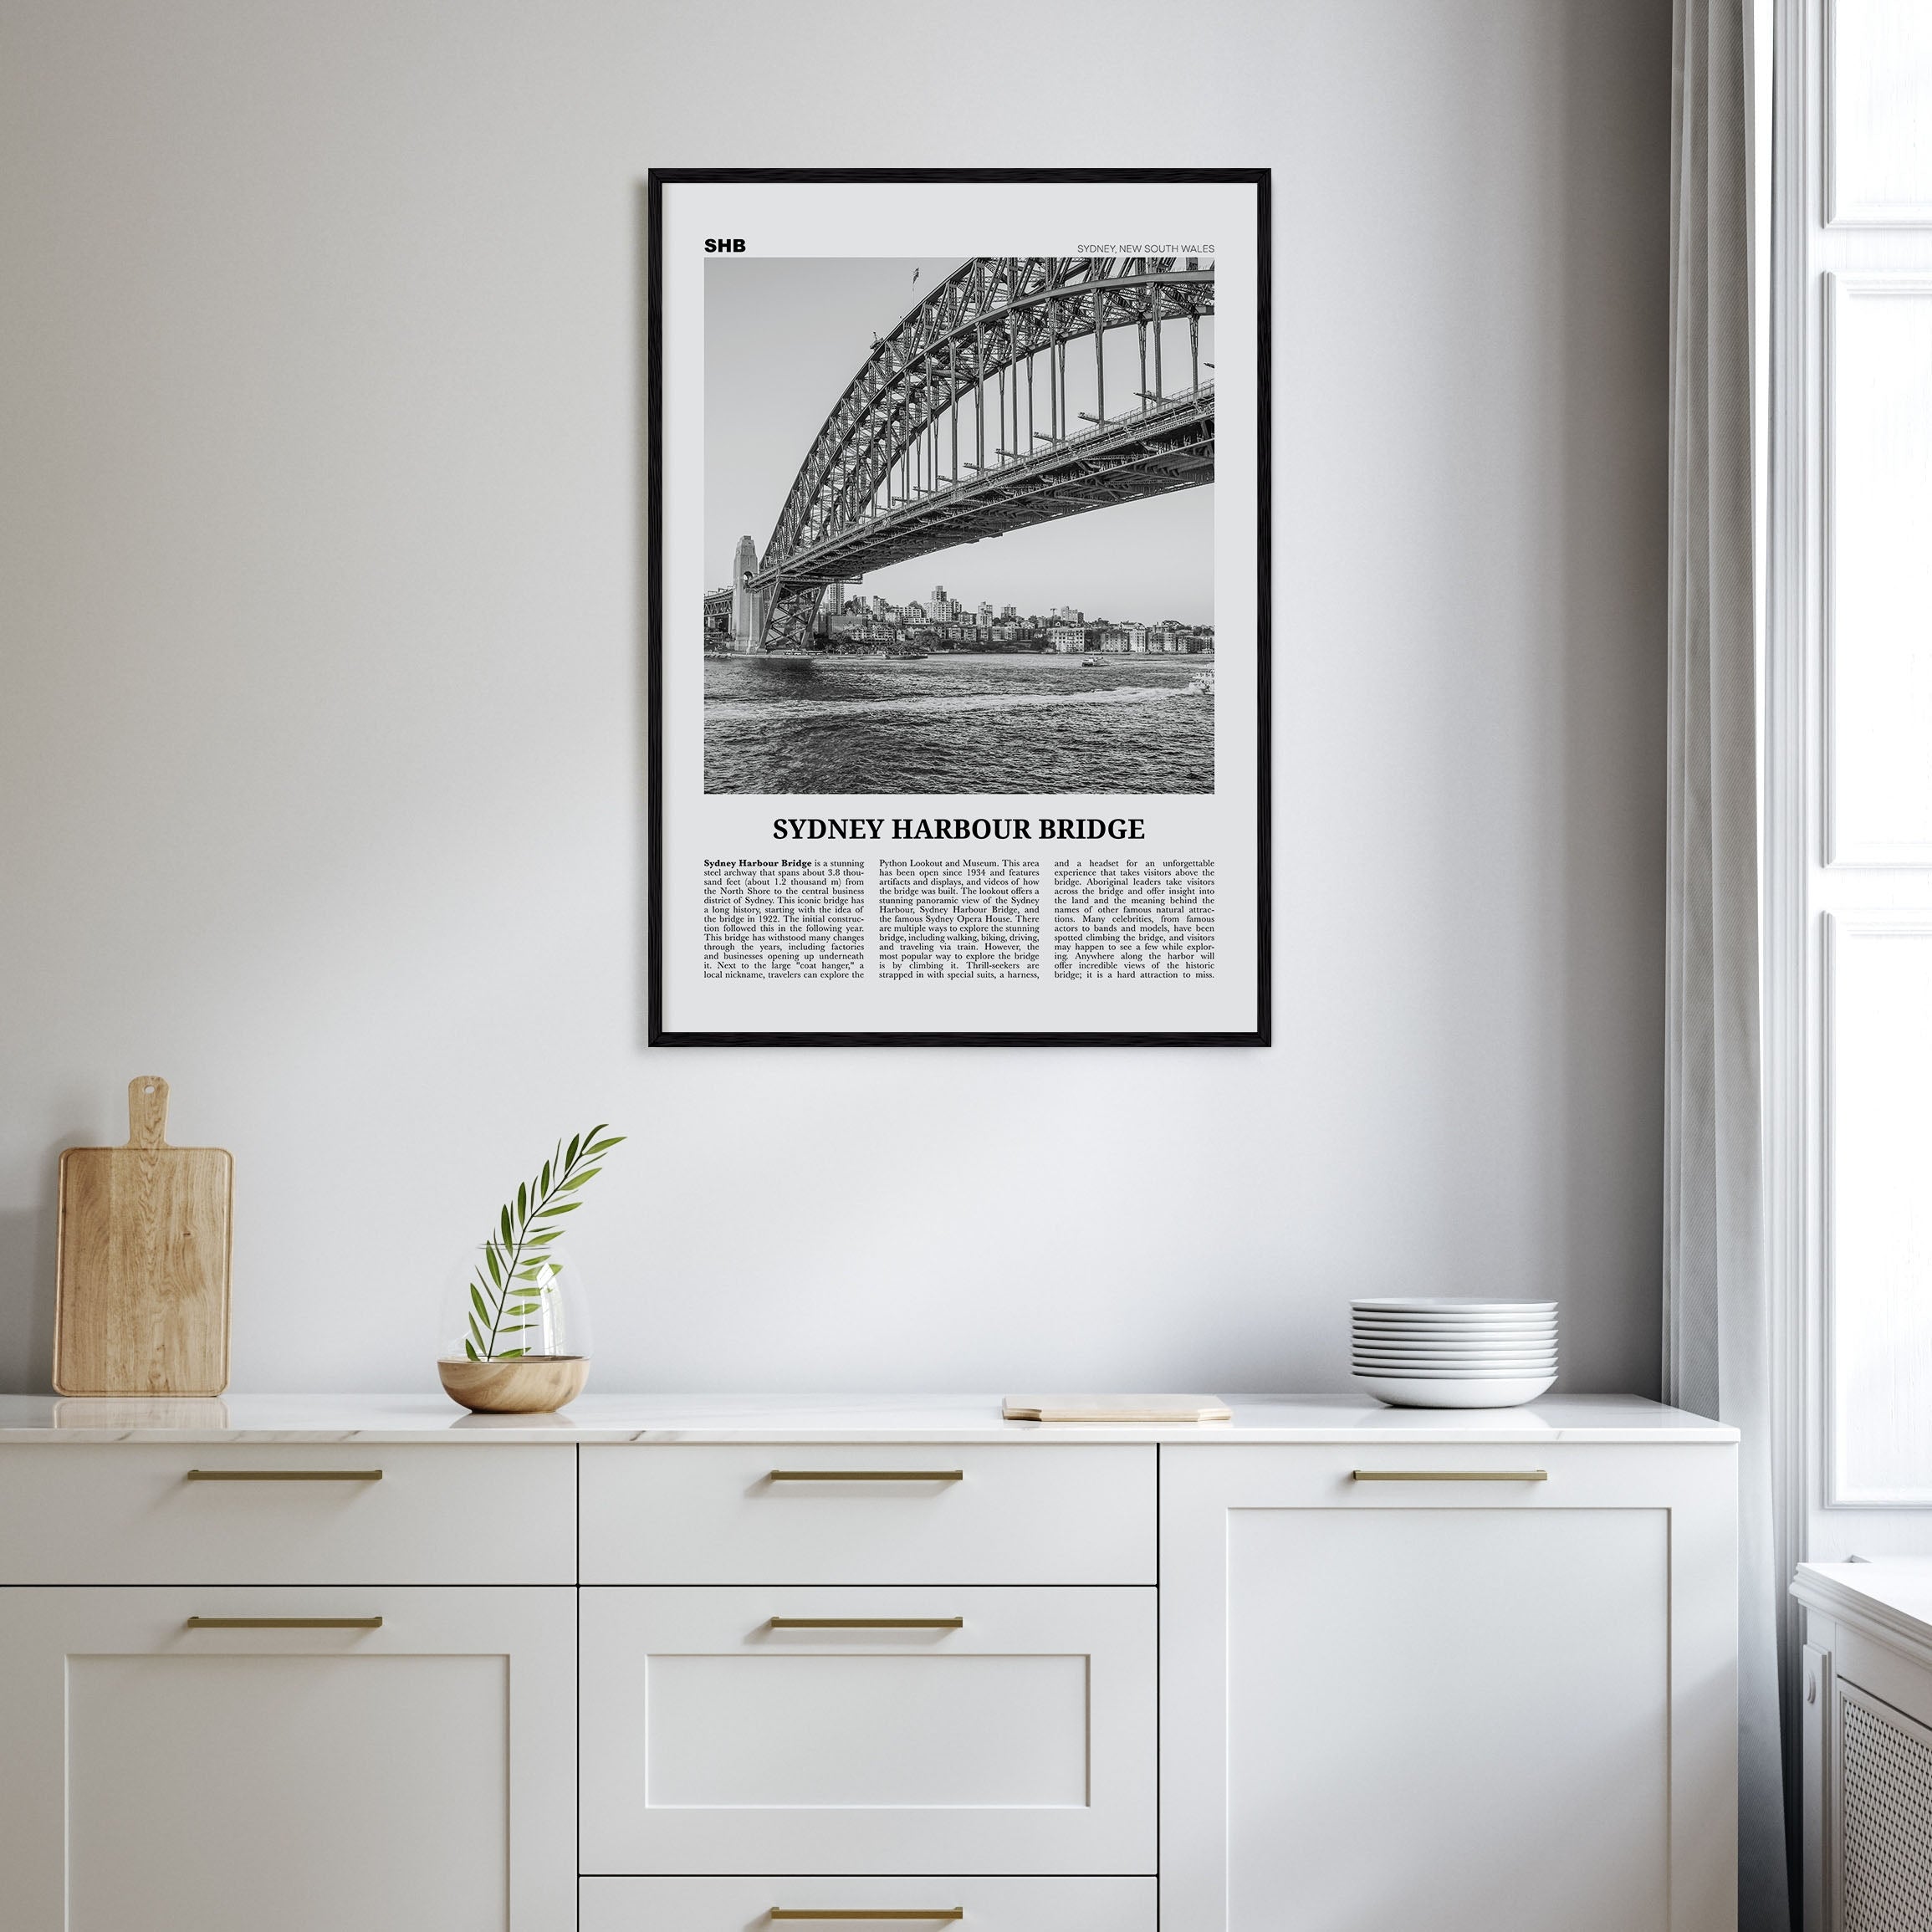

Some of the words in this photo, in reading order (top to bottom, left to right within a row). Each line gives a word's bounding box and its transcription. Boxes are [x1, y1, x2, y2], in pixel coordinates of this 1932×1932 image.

[704, 238, 746, 253] SHB
[1077, 244, 1117, 253] SYDNEY,
[1119, 244, 1142, 253] NEW
[1144, 244, 1178, 253] SOUTH
[1180, 244, 1215, 253] WALES
[773, 819, 886, 839] SYDNEY
[892, 819, 1032, 839] HARBOUR
[1038, 819, 1146, 839] BRIDGE
[703, 859, 737, 869] Sydney
[781, 859, 813, 869] Bridge
[830, 860, 865, 869] stunning
[879, 859, 907, 869] Python
[1163, 859, 1215, 869] unforgettable
[744, 878, 770, 887] (about
[831, 878, 841, 887] m)
[930, 878, 963, 887] displays,
[1054, 878, 1082, 887] bridge.
[1086, 878, 1128, 887] Aboriginal
[744, 897, 774, 906] Sydney.
[823, 897, 849, 906] bridge
[878, 897, 913, 906] stunning
[916, 897, 958, 906] panoramic
[1010, 897, 1040, 906] Sydney
[1131, 897, 1166, 906] meaning
[719, 915, 745, 924] bridge
[925, 915, 954, 924] Sydney
[956, 915, 983, 924] Opera
[1082, 915, 1106, 924] Many
[1112, 915, 1154, 923] celebrities,
[724, 933, 750, 943] bridge
[832, 933, 865, 943] changes
[879, 933, 907, 943] bridge,
[908, 933, 946, 943] including
[946, 933, 979, 943] walking,
[980, 933, 1008, 943] biking,
[1009, 933, 1040, 943] driving,
[1054, 933, 1083, 943] spotted
[1086, 933, 1121, 943] climbing
[1138, 933, 1167, 943] bridge,
[767, 953, 800, 961] opening
[901, 952, 933, 961] popular
[965, 952, 995, 961] explore
[1014, 952, 1040, 961] bridge
[1054, 953, 1069, 961] ing.
[1075, 952, 1115, 961] Anywhere
[1120, 952, 1143, 961] along
[724, 970, 766, 979] nickname,
[820, 970, 850, 980] explore
[878, 970, 913, 980] strapped
[947, 970, 974, 980] special
[1007, 970, 1040, 979] harness,
[1054, 970, 1082, 980] bridge;
